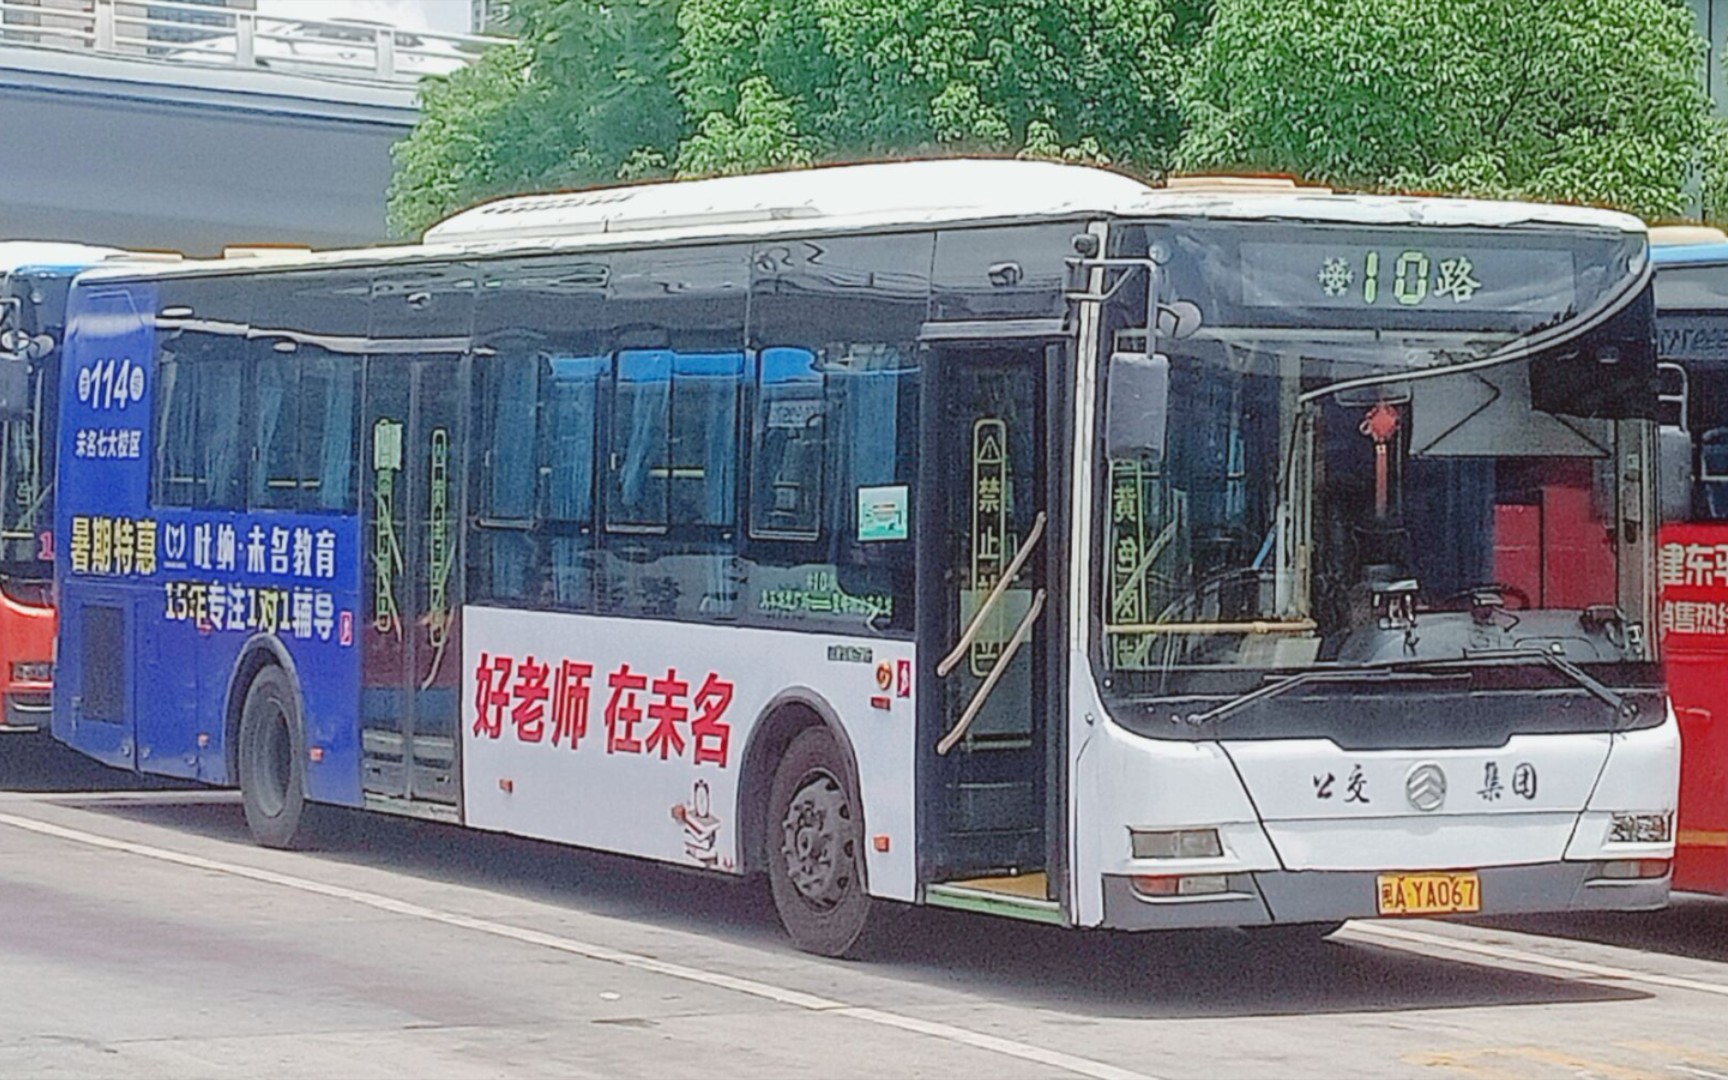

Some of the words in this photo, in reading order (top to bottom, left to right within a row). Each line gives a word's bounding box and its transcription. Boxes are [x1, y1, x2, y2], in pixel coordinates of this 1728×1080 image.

[75, 428, 142, 458] 未名七大校区
[70, 516, 157, 576] 暑期特惠
[165, 579, 335, 641] 15年专注1对1辅导
[473, 652, 593, 750] 好老师
[604, 664, 734, 769] 在未名
[1312, 764, 1371, 804] 公交
[1476, 761, 1538, 801] 集团
